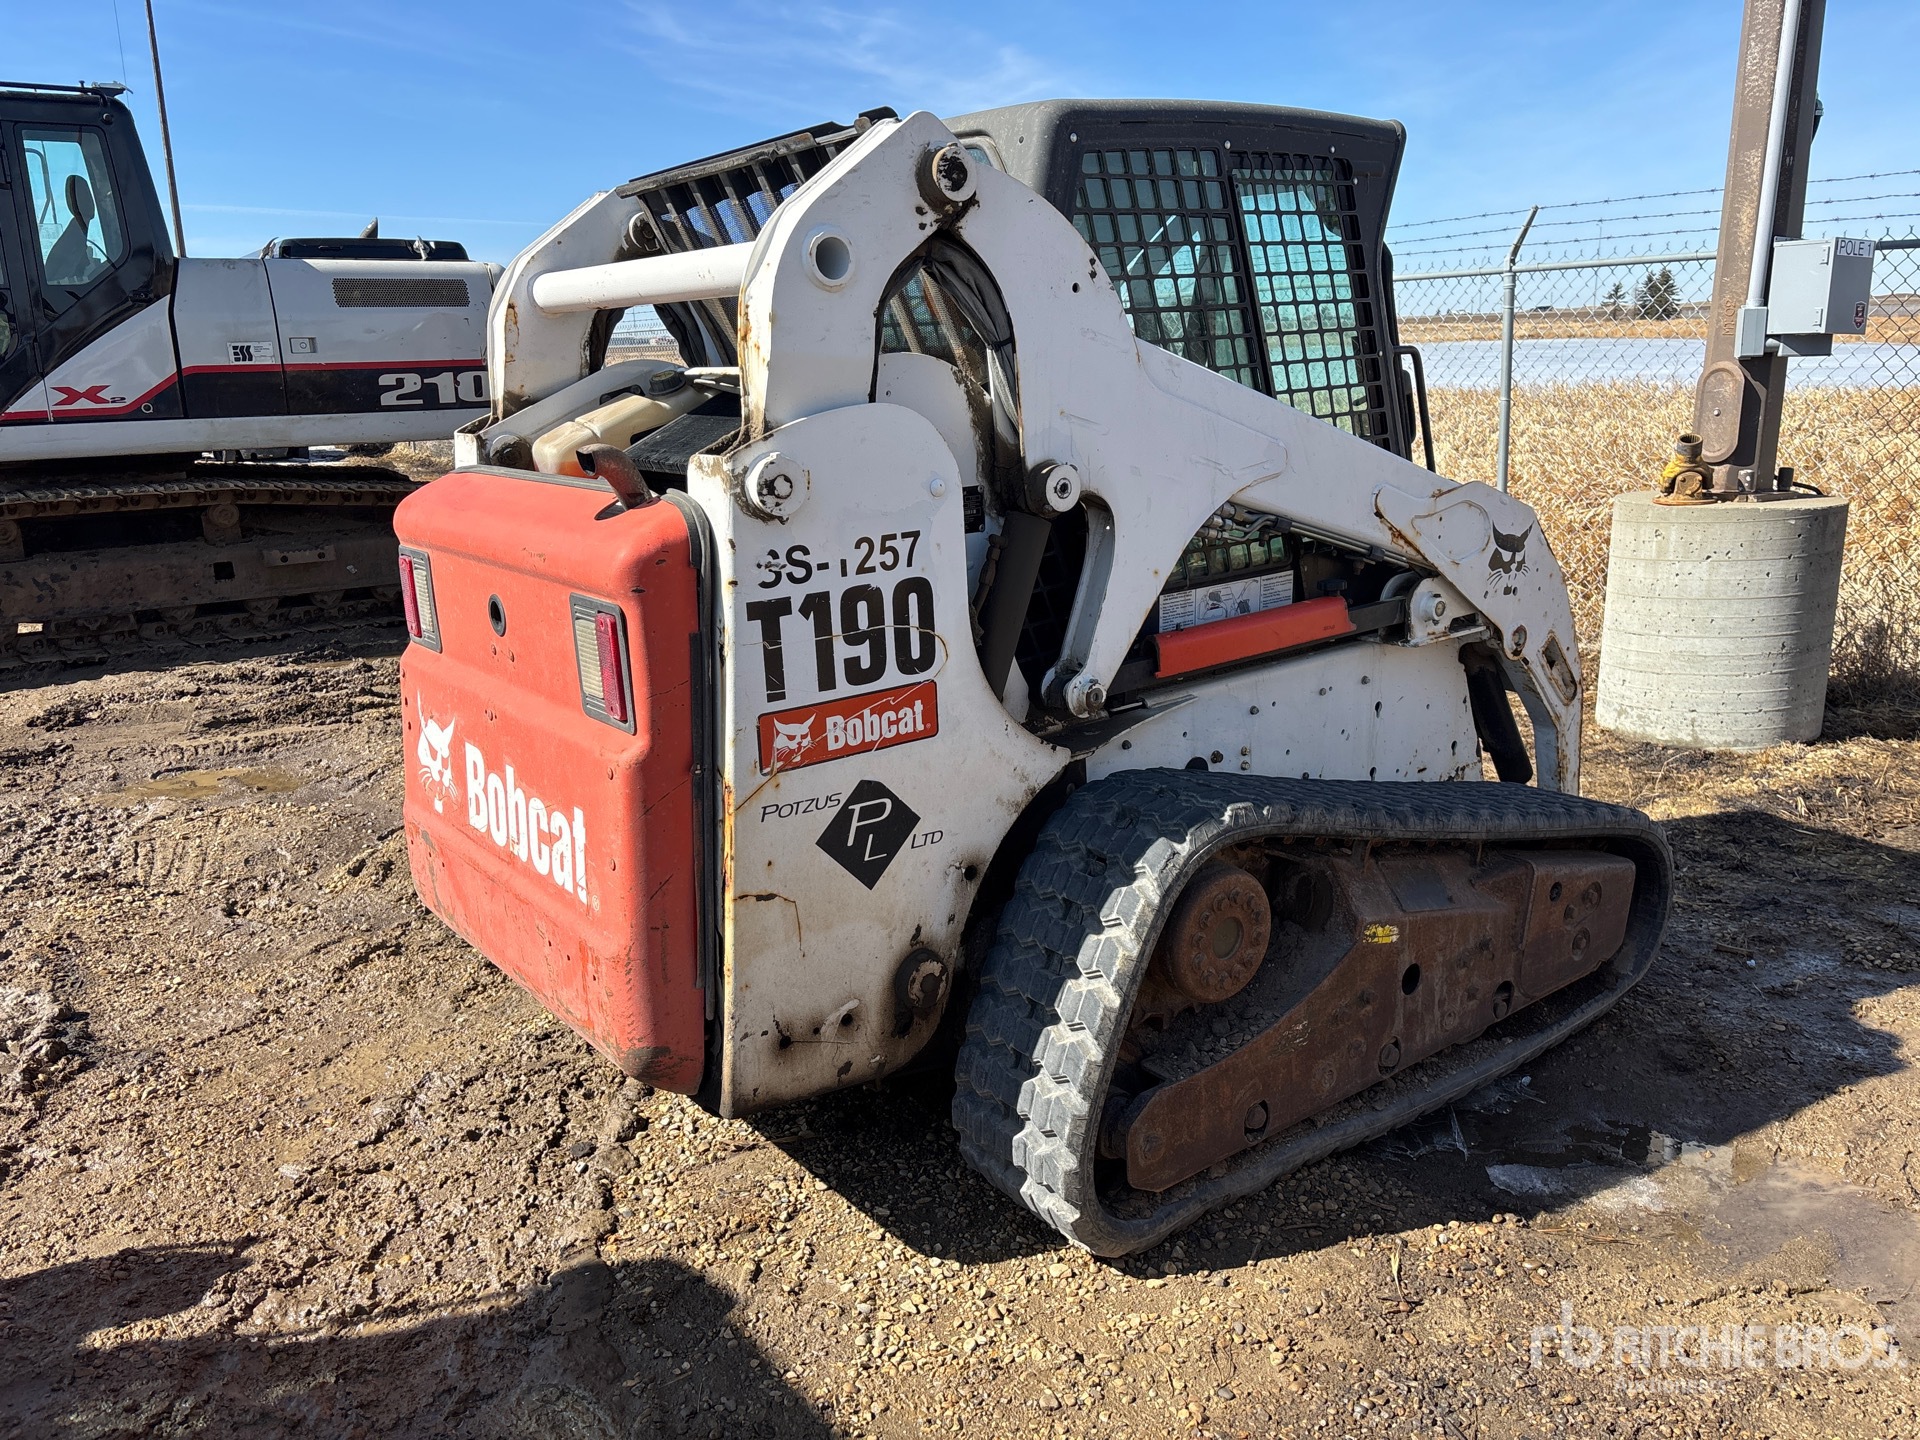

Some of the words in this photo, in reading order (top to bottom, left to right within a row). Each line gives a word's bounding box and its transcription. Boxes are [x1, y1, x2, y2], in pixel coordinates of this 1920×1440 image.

[1839, 240, 1865, 256] POLE
[378, 370, 490, 406] 210
[746, 576, 936, 703] T190
[825, 699, 925, 751] Bobcat
[464, 741, 588, 906] Bobcat
[761, 792, 843, 823] POTZUS
[910, 830, 944, 850] LTD
